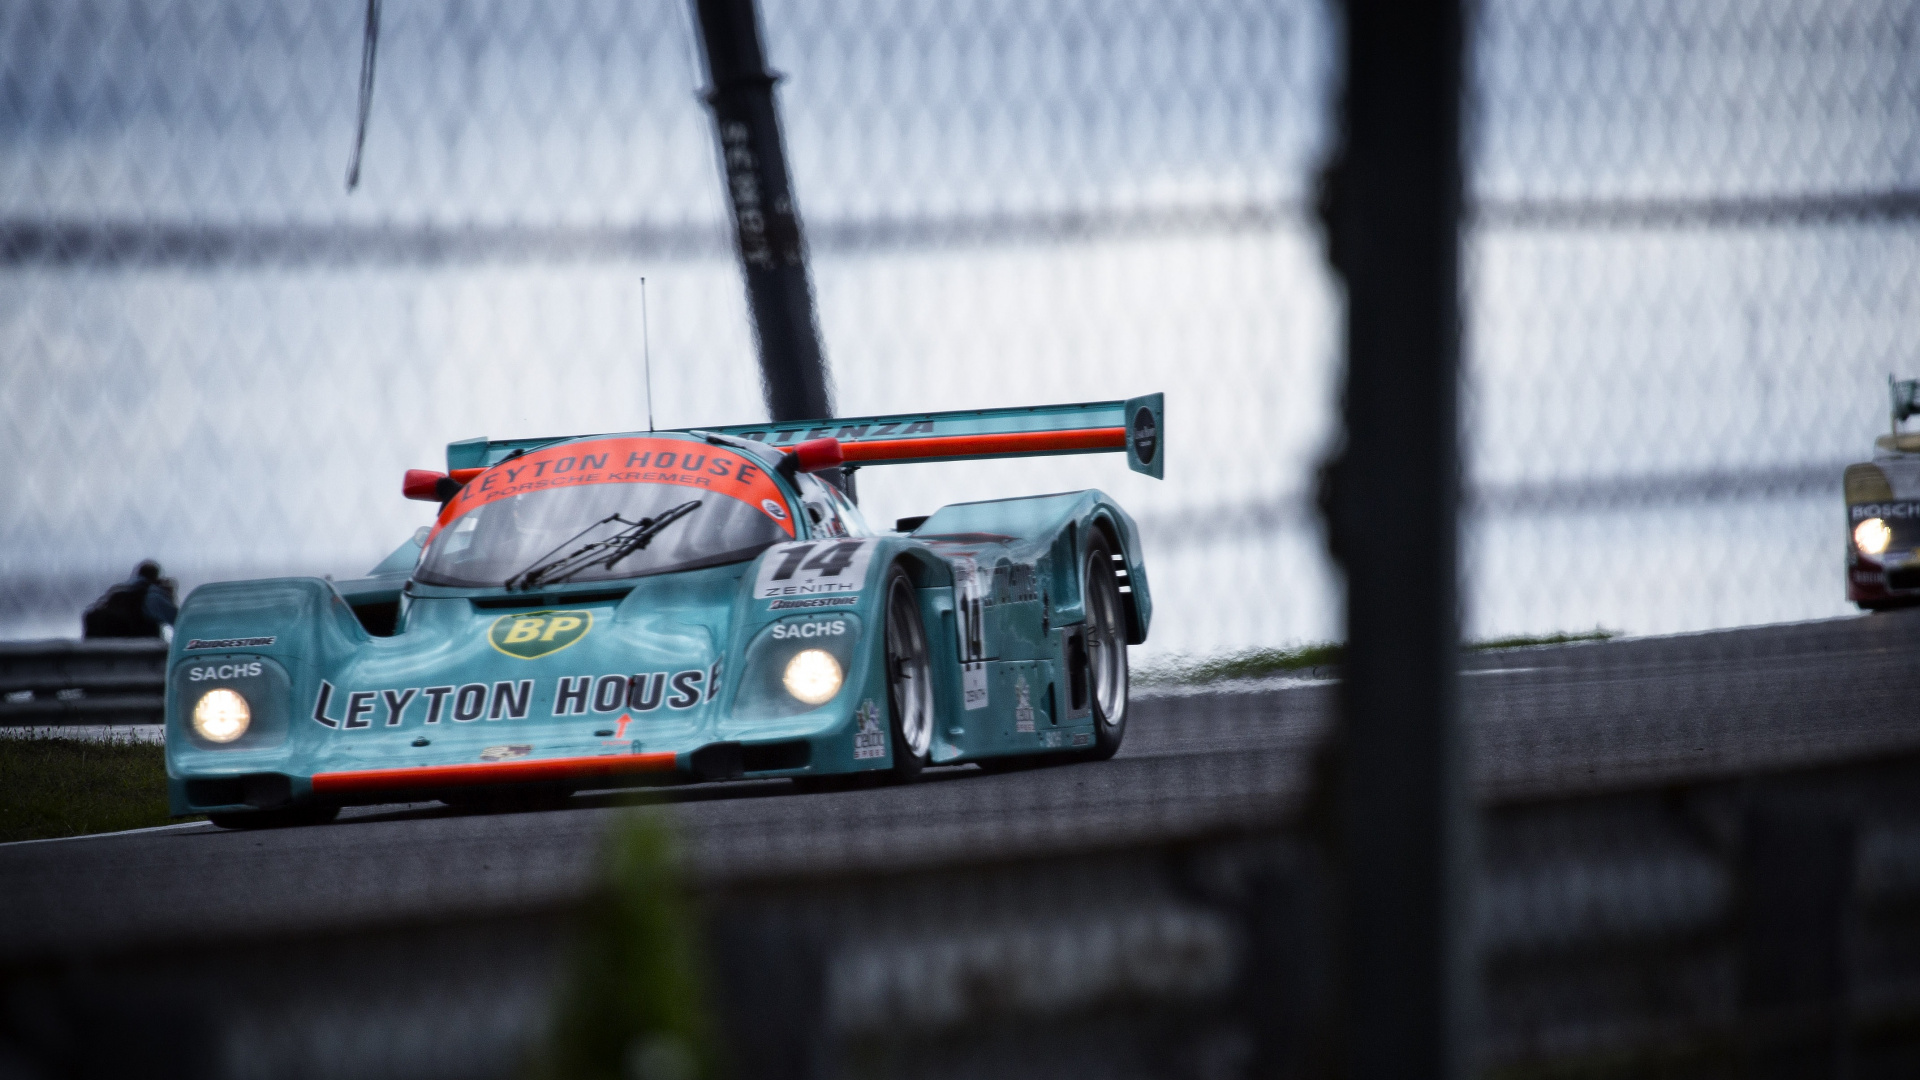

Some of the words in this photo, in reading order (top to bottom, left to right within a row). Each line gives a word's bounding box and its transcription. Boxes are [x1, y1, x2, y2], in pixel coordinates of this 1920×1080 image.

[461, 451, 609, 501] LEYTON
[625, 451, 759, 486] HOUSE
[486, 473, 600, 500] PORSCHE
[608, 471, 712, 487] KREMER
[1852, 503, 1920, 520] BOSCH
[770, 541, 866, 581] 14
[764, 583, 854, 597] ZENITH
[769, 596, 859, 610] BRIDGESTONE
[503, 616, 582, 645] BP
[772, 620, 846, 640] SACHS
[189, 662, 262, 682] SACHS
[312, 679, 535, 730] LEYTON
[551, 656, 724, 716] HOUSE
